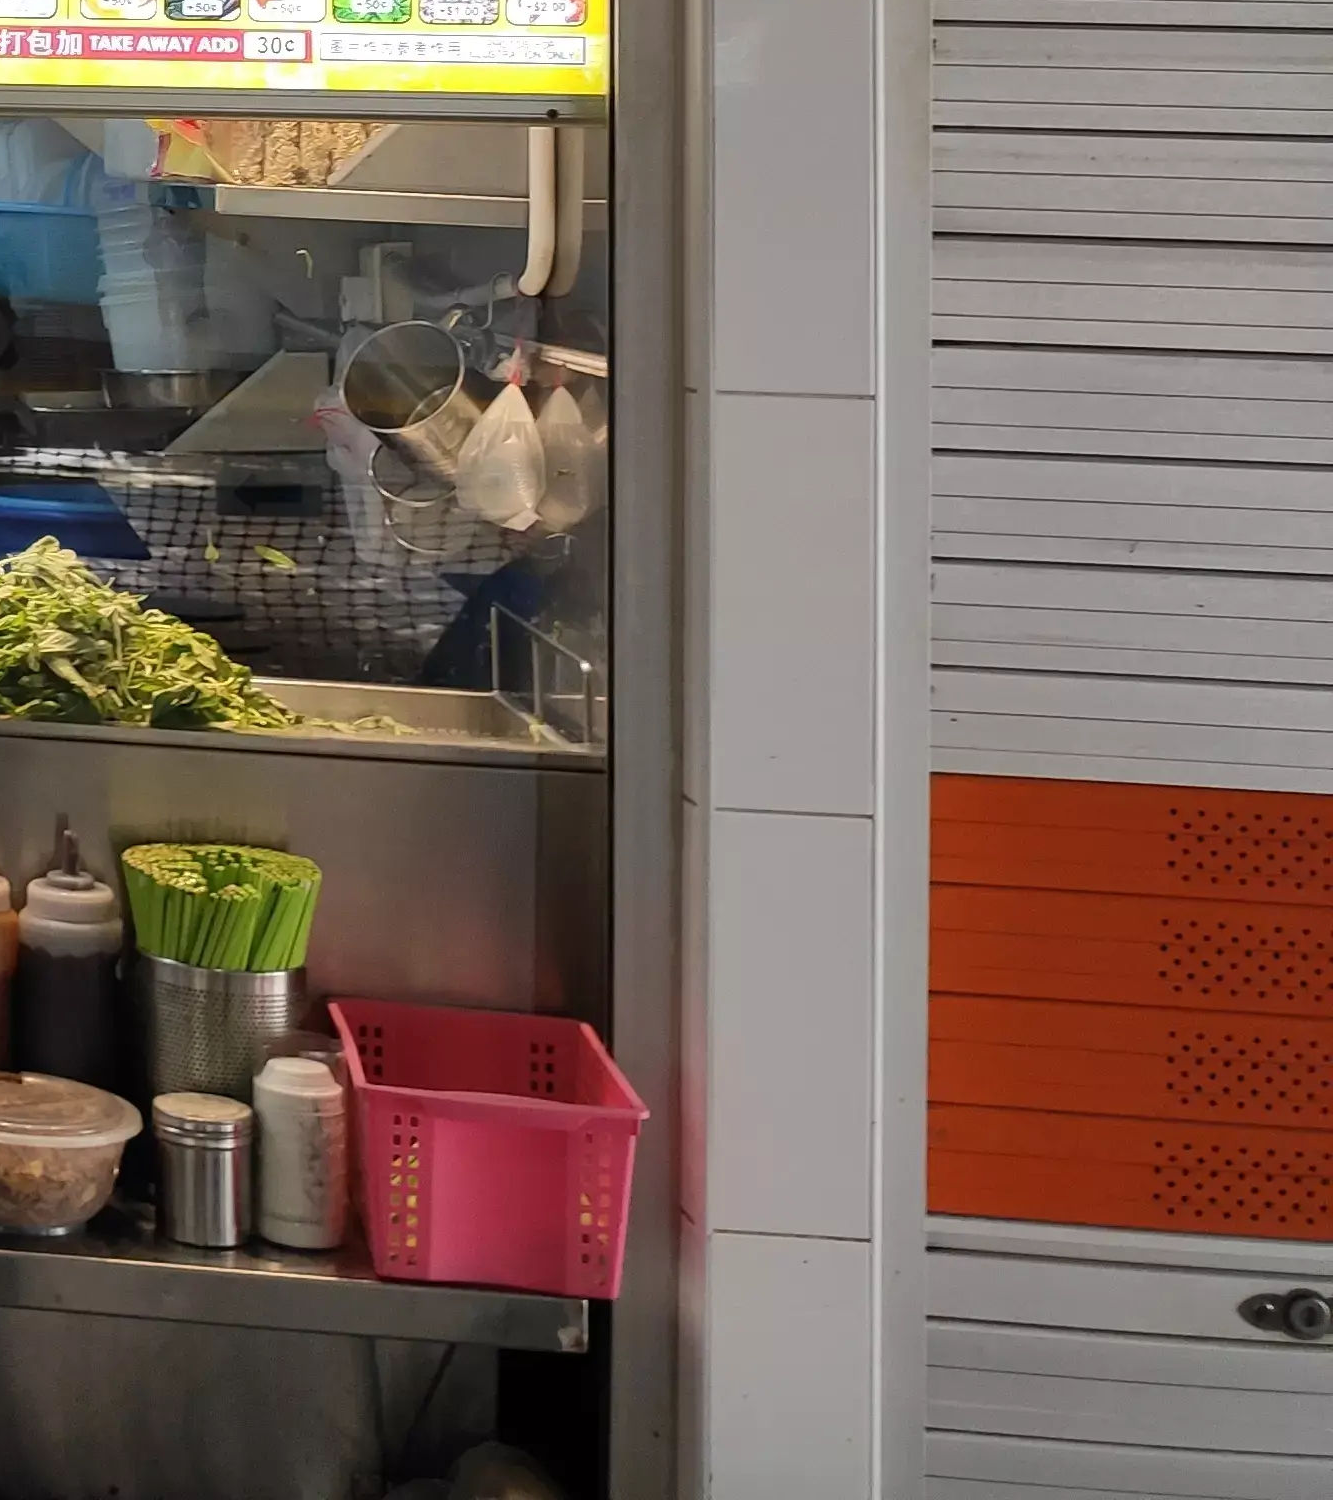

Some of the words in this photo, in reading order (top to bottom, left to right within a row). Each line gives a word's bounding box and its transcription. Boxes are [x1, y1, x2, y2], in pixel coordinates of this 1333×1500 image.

[88, 35, 134, 52] TAKE
[136, 35, 195, 53] AWAY
[196, 37, 239, 54] ADD
